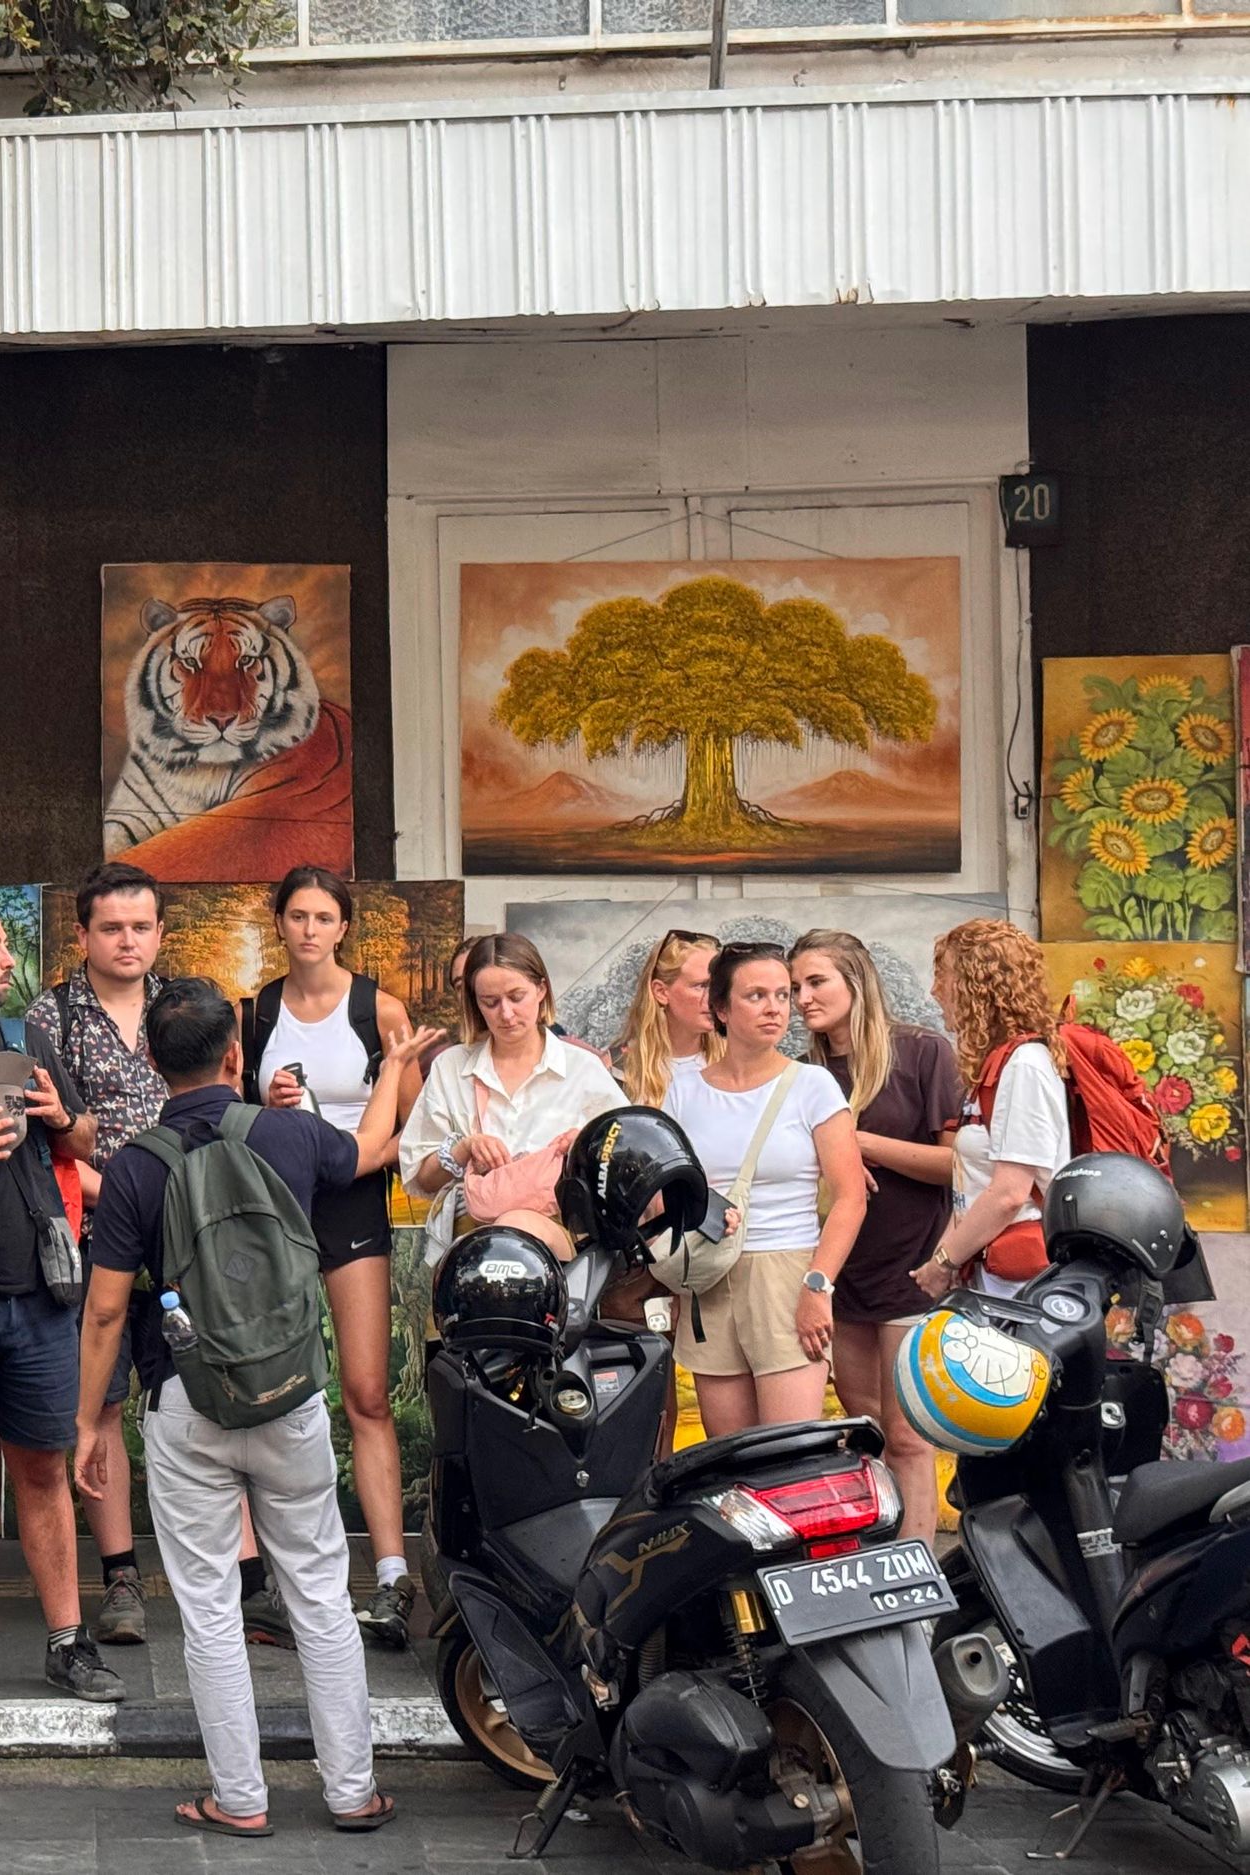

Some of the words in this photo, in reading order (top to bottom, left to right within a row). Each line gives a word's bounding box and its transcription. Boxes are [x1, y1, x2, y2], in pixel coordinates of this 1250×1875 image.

[1014, 484, 1050, 521] 20
[773, 1579, 793, 1605] D
[811, 1561, 873, 1596] 4544
[876, 1549, 931, 1582] ZDM
